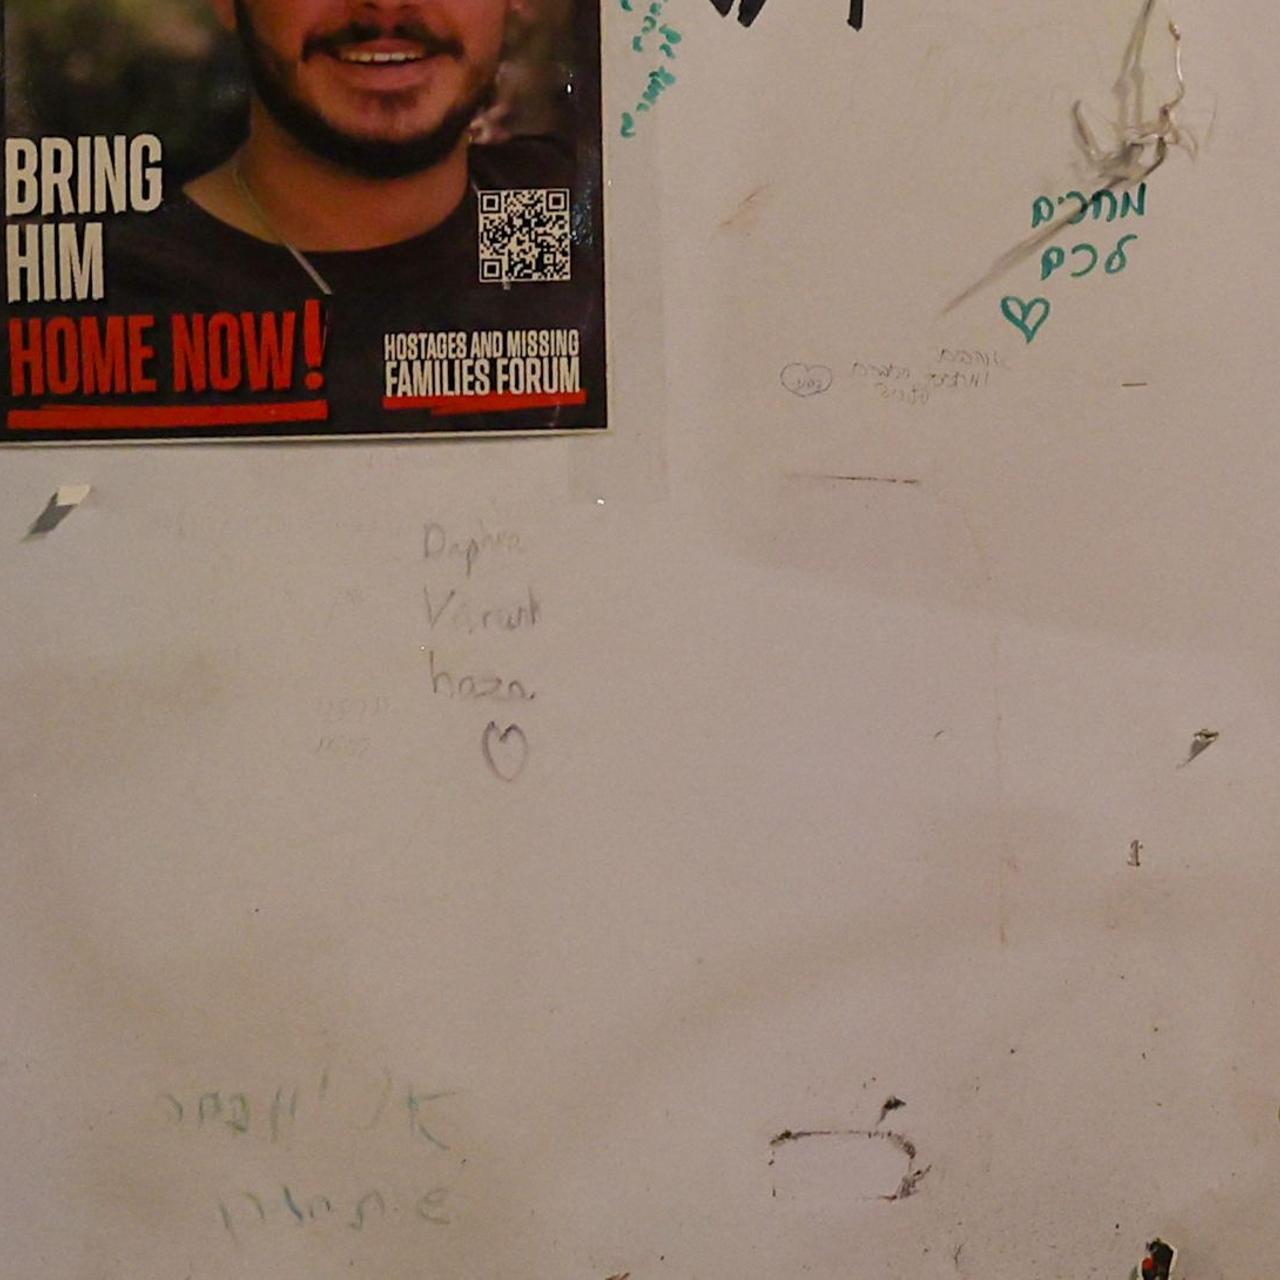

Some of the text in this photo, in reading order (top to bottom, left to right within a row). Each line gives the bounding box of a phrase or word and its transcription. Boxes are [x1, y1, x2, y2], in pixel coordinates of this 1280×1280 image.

[6, 135, 161, 215] BRING
[7, 223, 103, 302] HIM
[10, 300, 323, 394] HOME NOW!
[385, 330, 578, 363] HOSTAGES AND MISSING
[386, 357, 579, 396] FAMILIES FORUM
